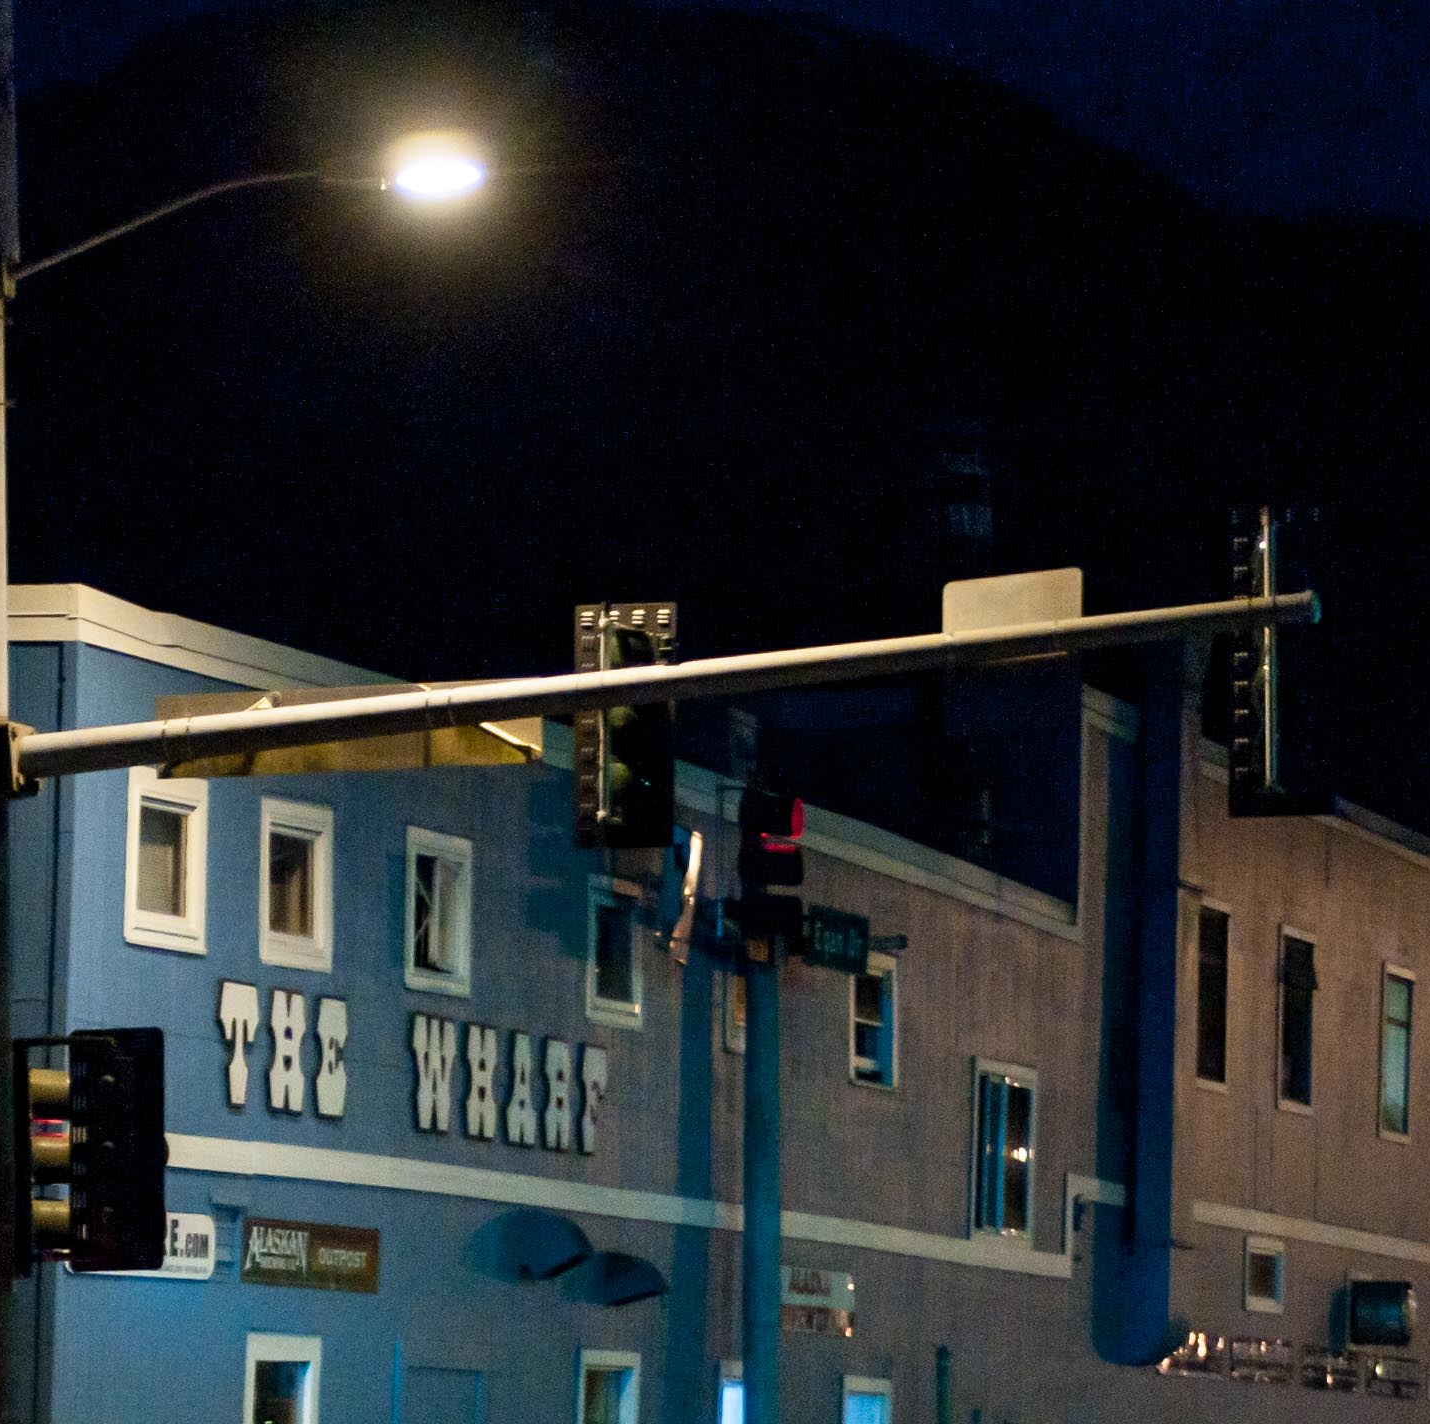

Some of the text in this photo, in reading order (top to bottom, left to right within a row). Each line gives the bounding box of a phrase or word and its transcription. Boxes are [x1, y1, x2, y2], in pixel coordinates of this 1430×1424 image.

[218, 980, 608, 1154] THE WHARF
[318, 1247, 368, 1268] OUTPOST
